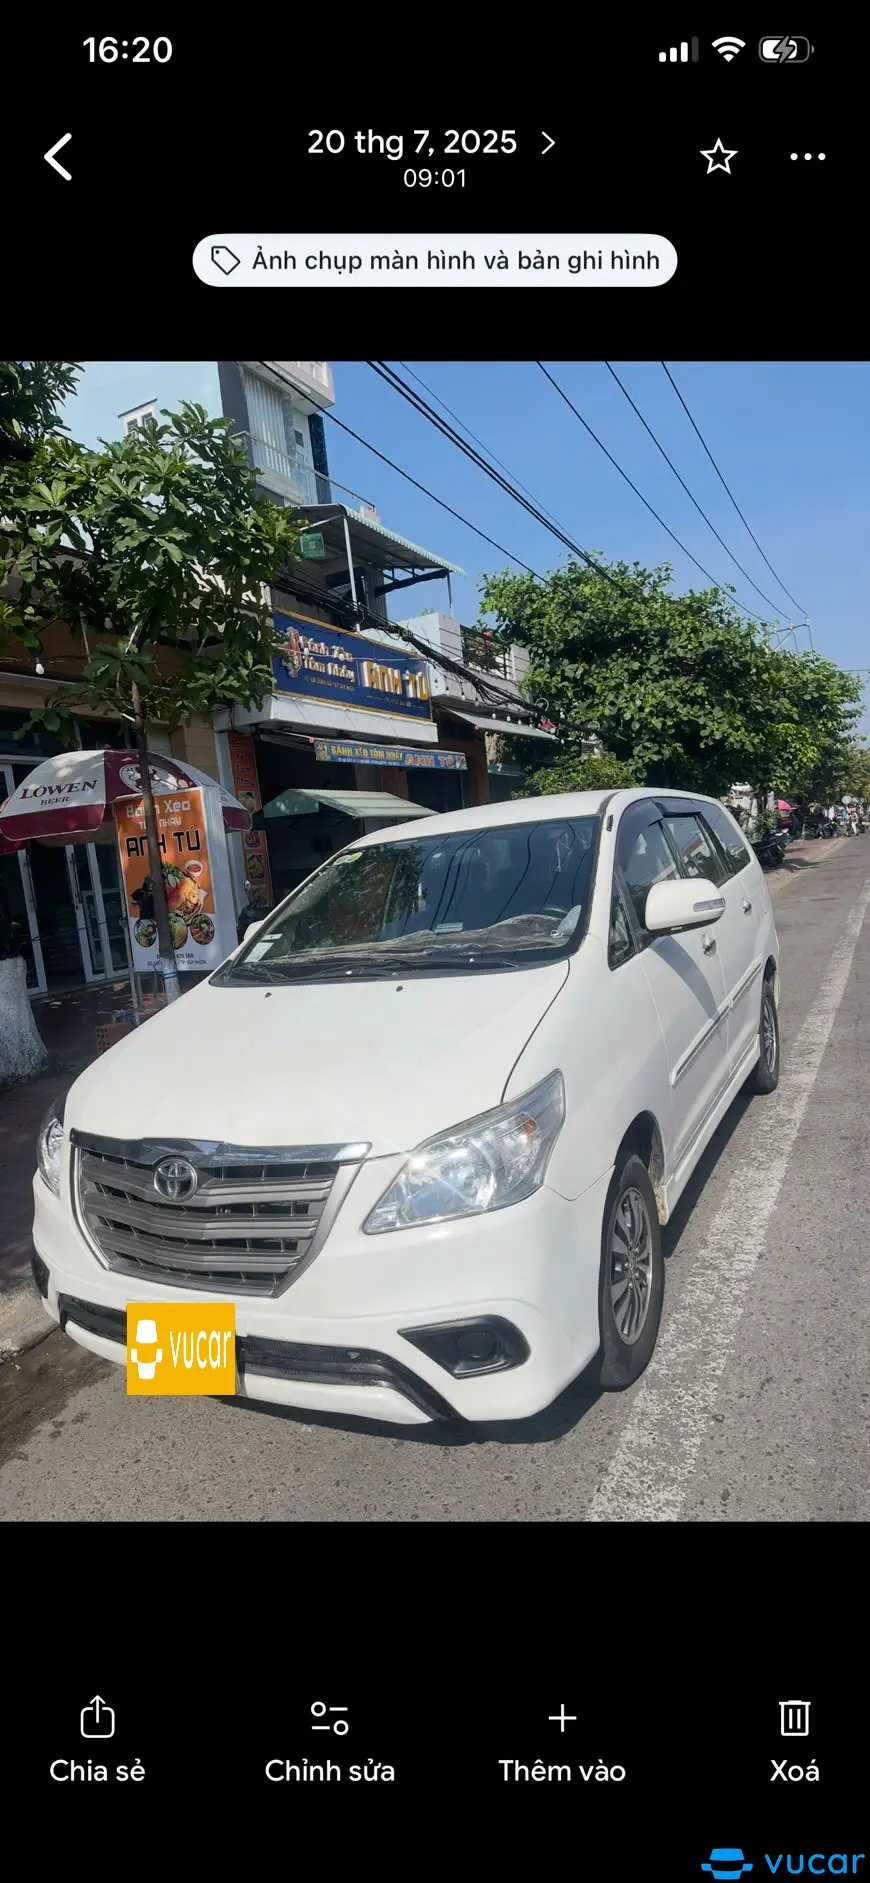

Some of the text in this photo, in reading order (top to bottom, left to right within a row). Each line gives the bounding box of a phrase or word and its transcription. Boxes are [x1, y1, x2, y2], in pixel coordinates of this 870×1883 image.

[363, 661, 402, 694] ANH
[41, 797, 70, 806] BEER
[173, 825, 201, 852] TÚ
